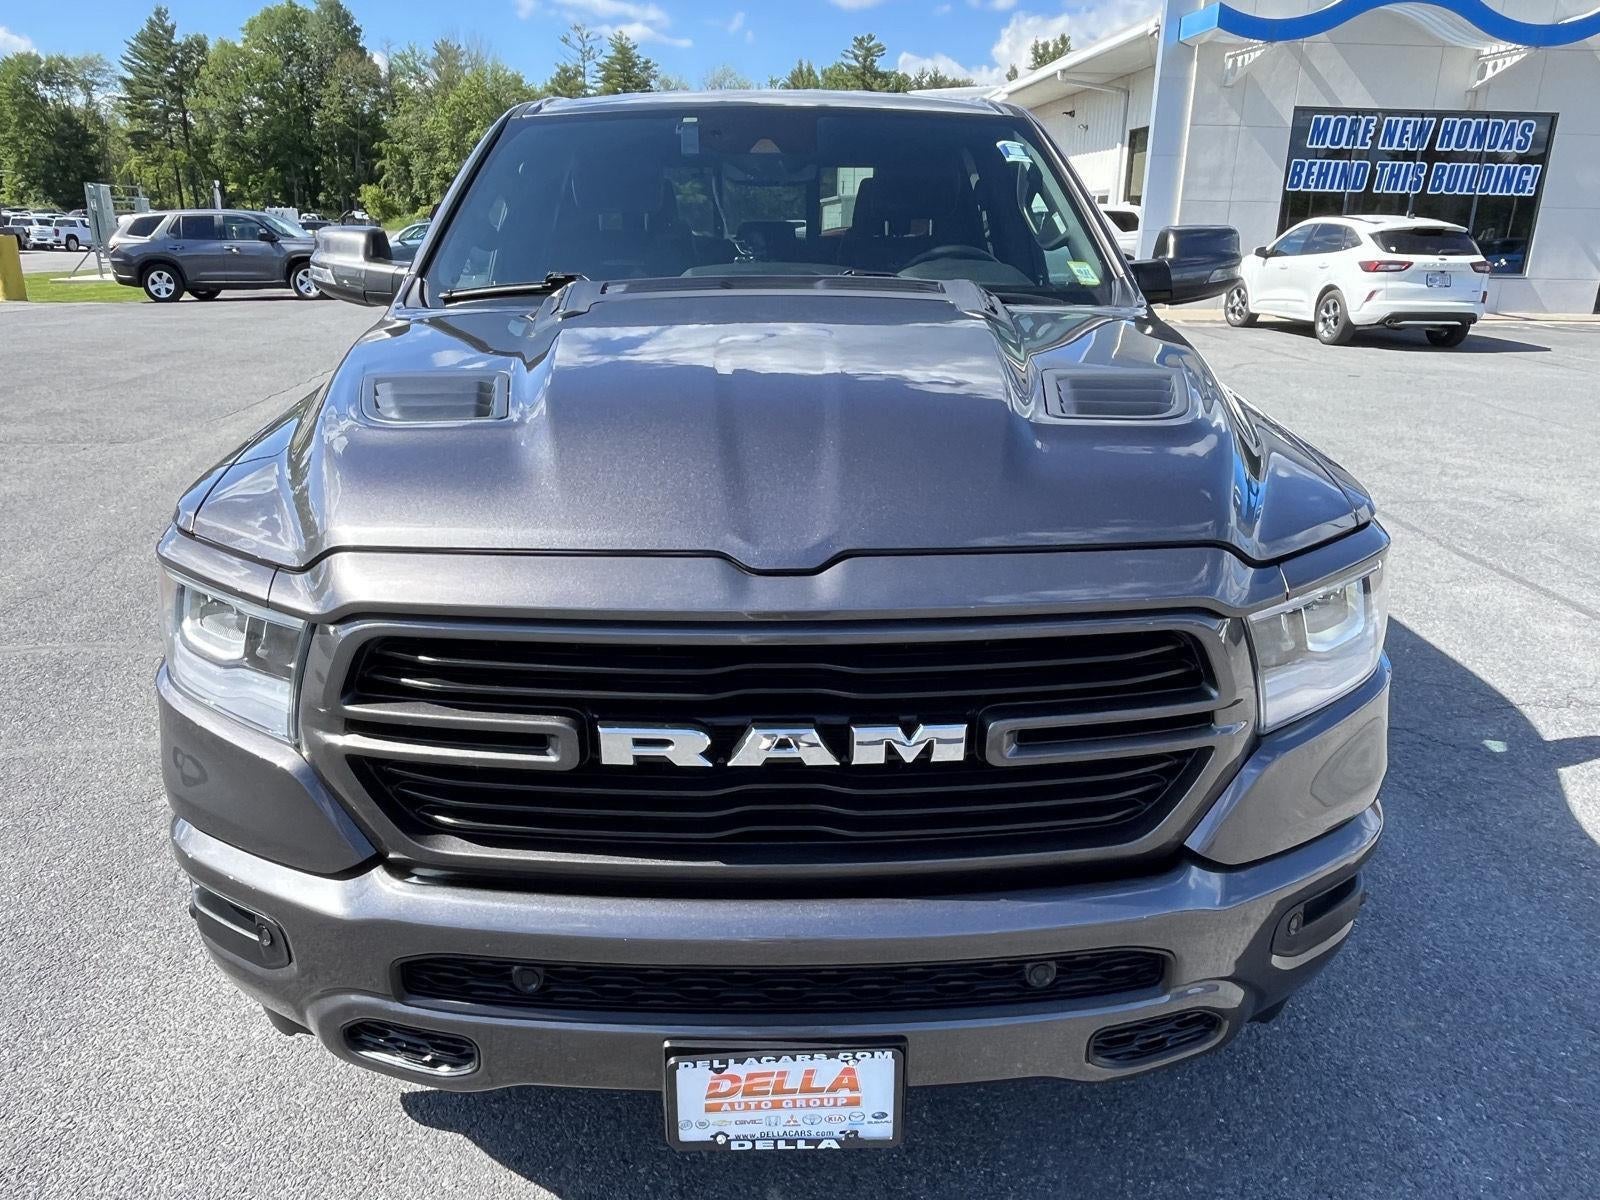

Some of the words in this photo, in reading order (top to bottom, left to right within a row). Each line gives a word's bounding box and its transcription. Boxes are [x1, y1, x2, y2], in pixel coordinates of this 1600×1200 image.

[1307, 114, 1377, 149] MORE
[1377, 116, 1436, 151] NEW
[1435, 117, 1537, 154] HONDAS
[1286, 159, 1371, 192] BEHIND
[1373, 160, 1427, 194] THIS
[1427, 162, 1542, 197] BUILDING!
[597, 721, 968, 767] RAM
[679, 1051, 894, 1069] DELLACARS.COM
[704, 1066, 861, 1101] DELLA
[720, 1101, 772, 1112] AUTO
[782, 1097, 849, 1109] GROUP
[730, 1139, 841, 1151] DELLA
[734, 1130, 835, 1140] www.DELLACARS.com
